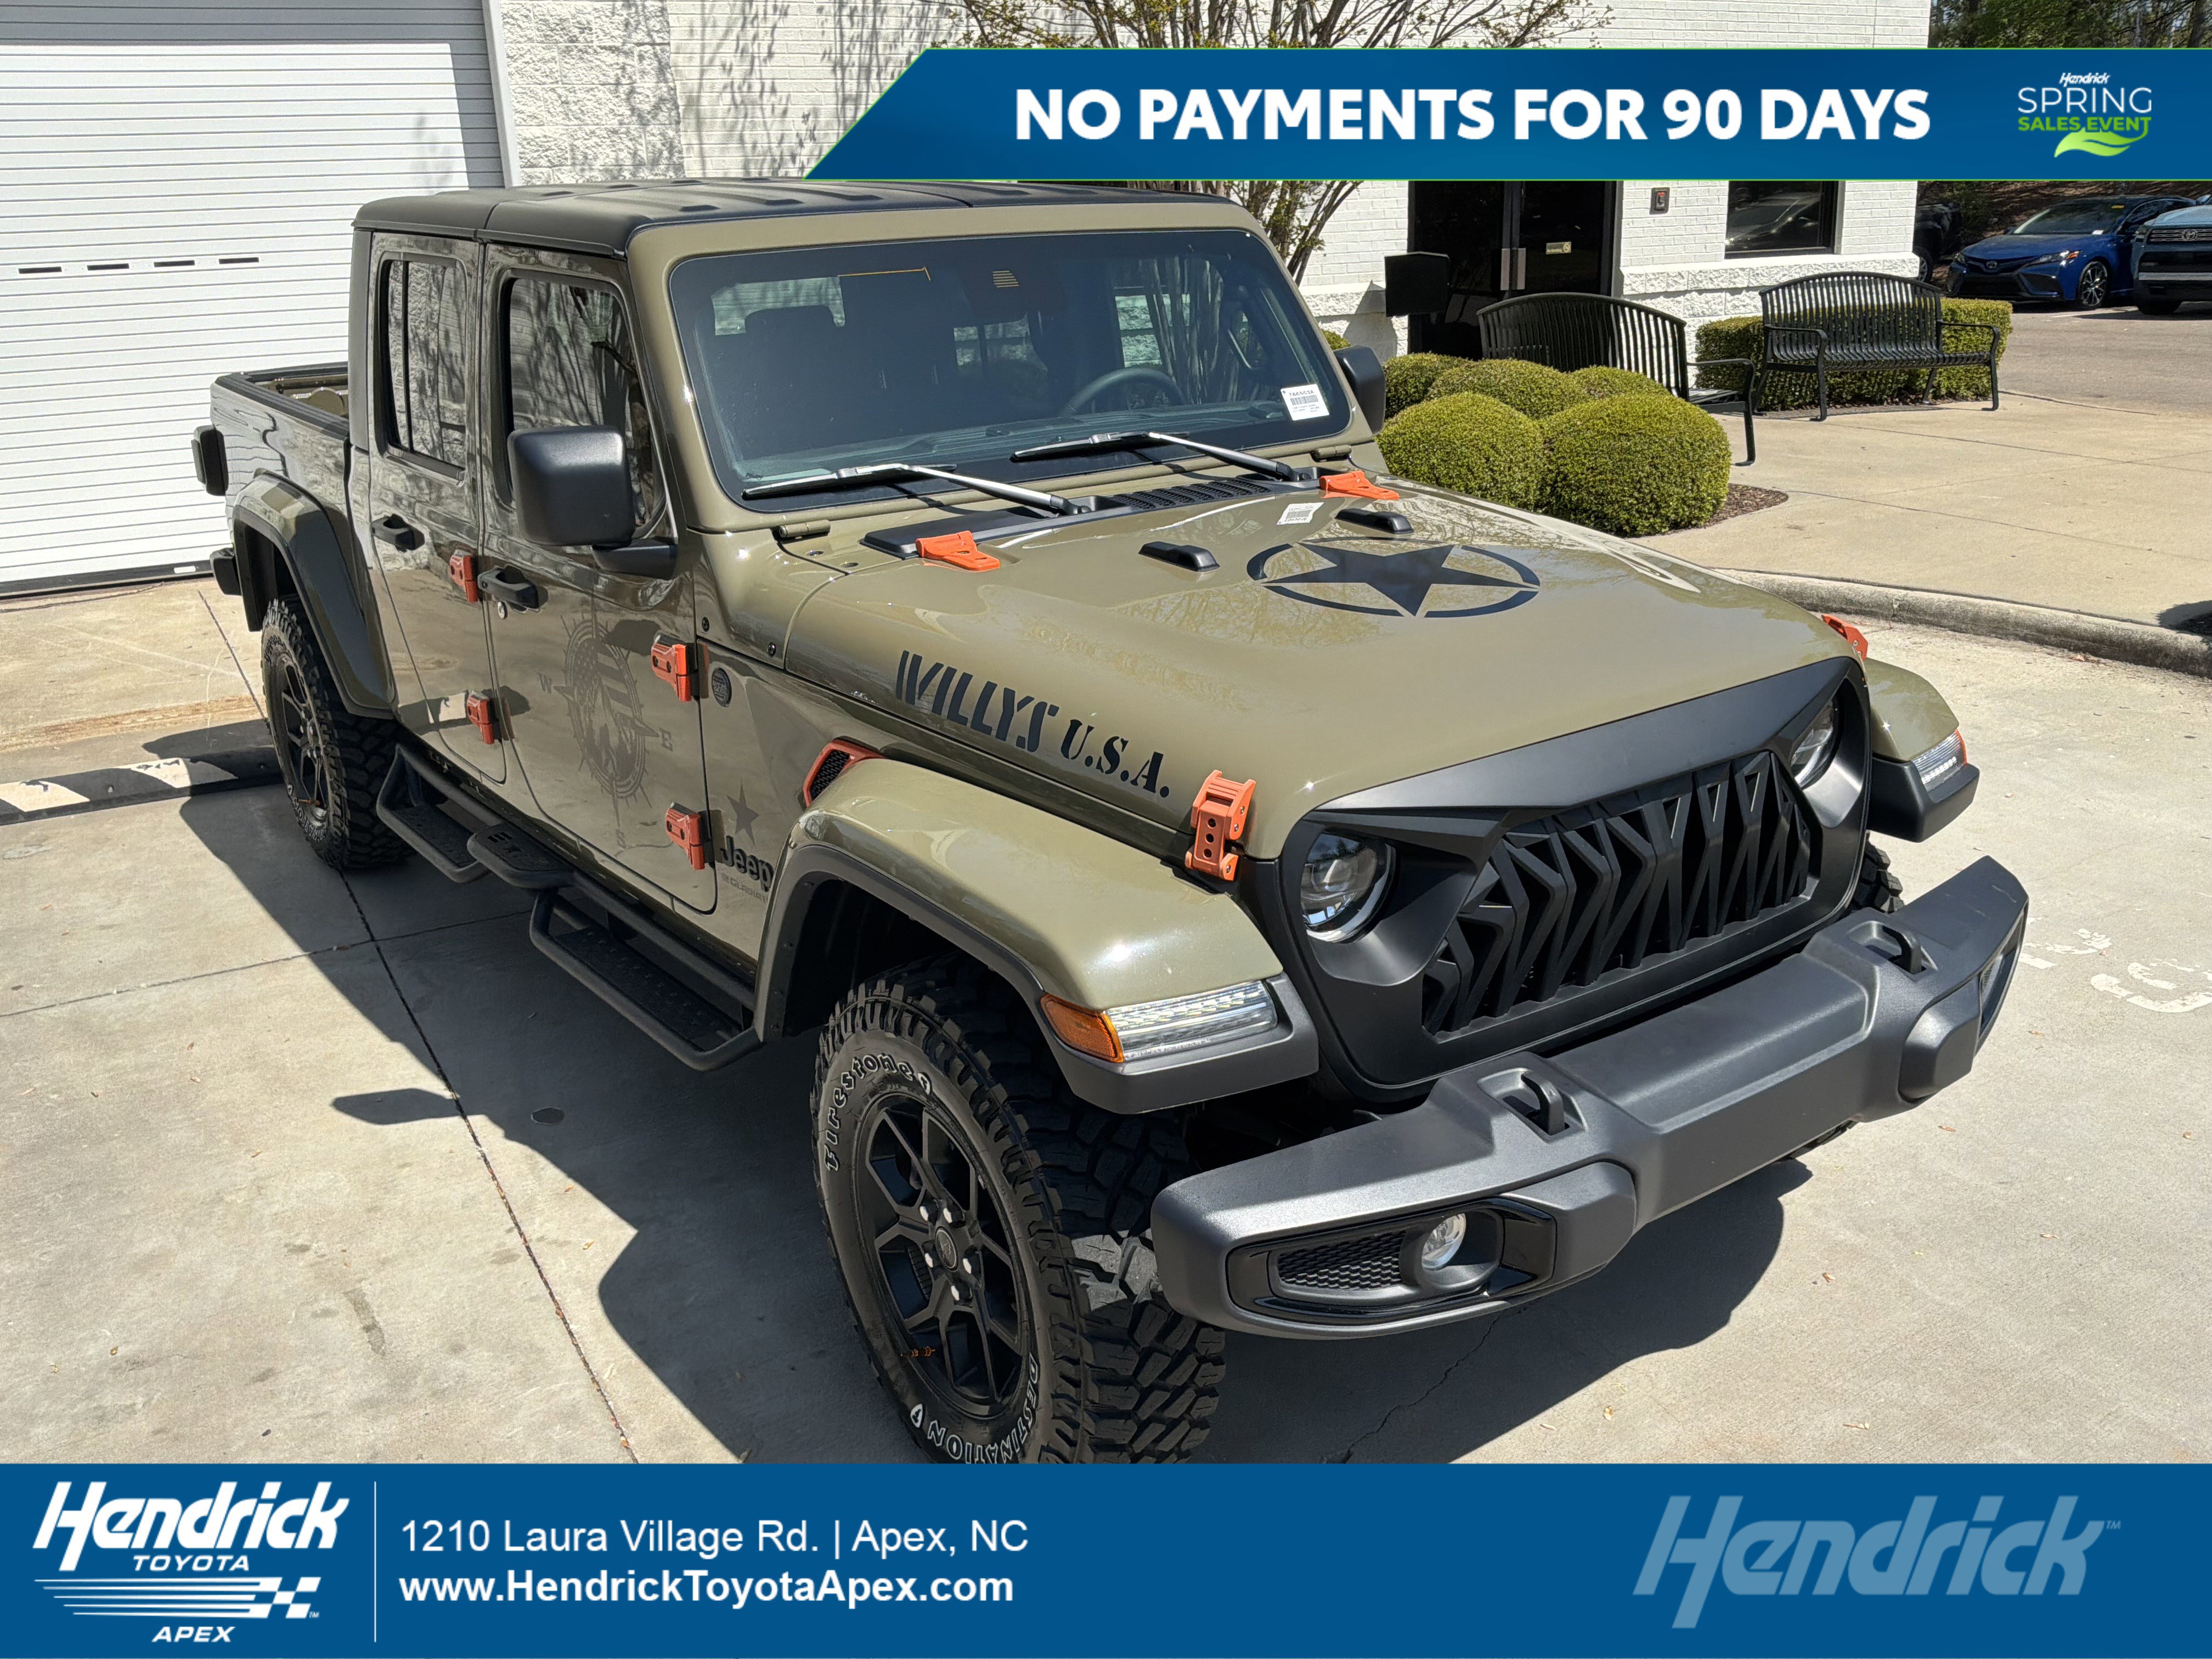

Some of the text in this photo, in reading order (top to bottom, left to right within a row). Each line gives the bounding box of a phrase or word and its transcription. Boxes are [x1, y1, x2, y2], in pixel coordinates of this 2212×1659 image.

[895, 650, 1170, 798] WILLYS U.S.A.
[720, 835, 774, 892] Jeep
[823, 1053, 917, 1172] Firestone
[927, 1351, 1039, 1464] DESTINATION
